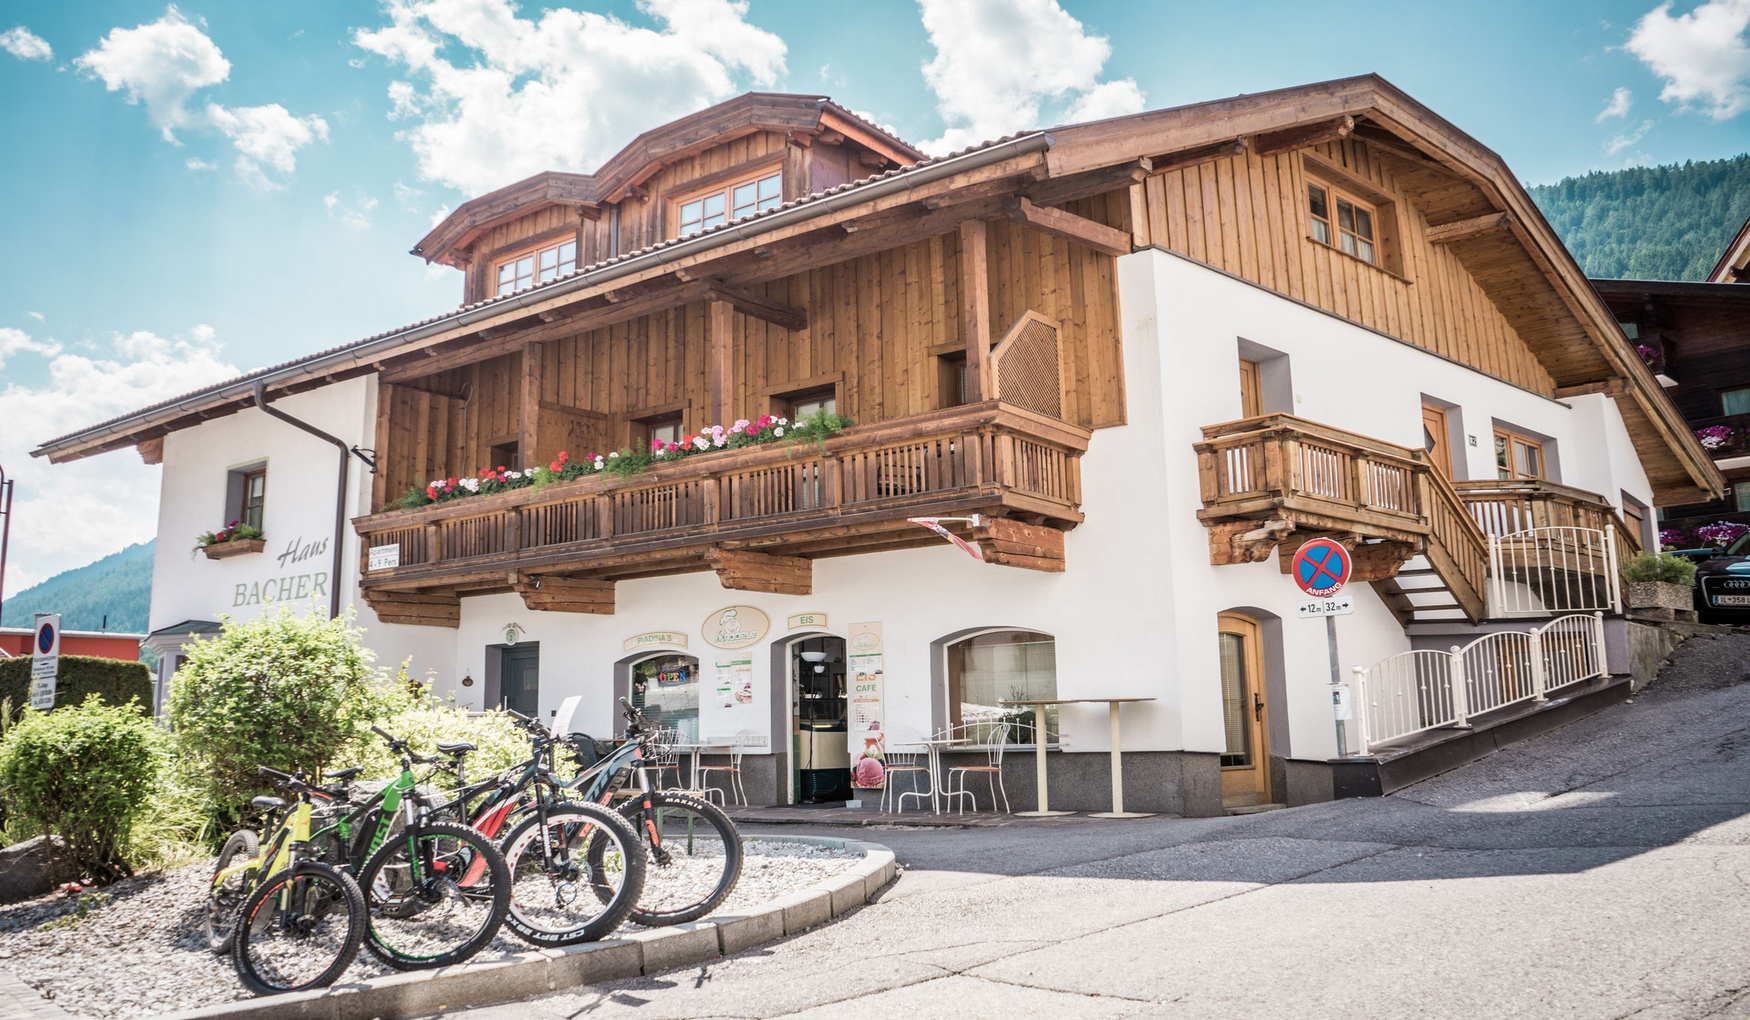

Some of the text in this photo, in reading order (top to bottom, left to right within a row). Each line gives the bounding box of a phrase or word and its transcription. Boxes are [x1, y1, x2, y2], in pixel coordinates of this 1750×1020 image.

[277, 536, 329, 569] Haus
[232, 572, 329, 607] BACHER
[1306, 582, 1342, 596] ANFANG
[800, 615, 814, 625] EIS
[659, 671, 687, 683] OPEN
